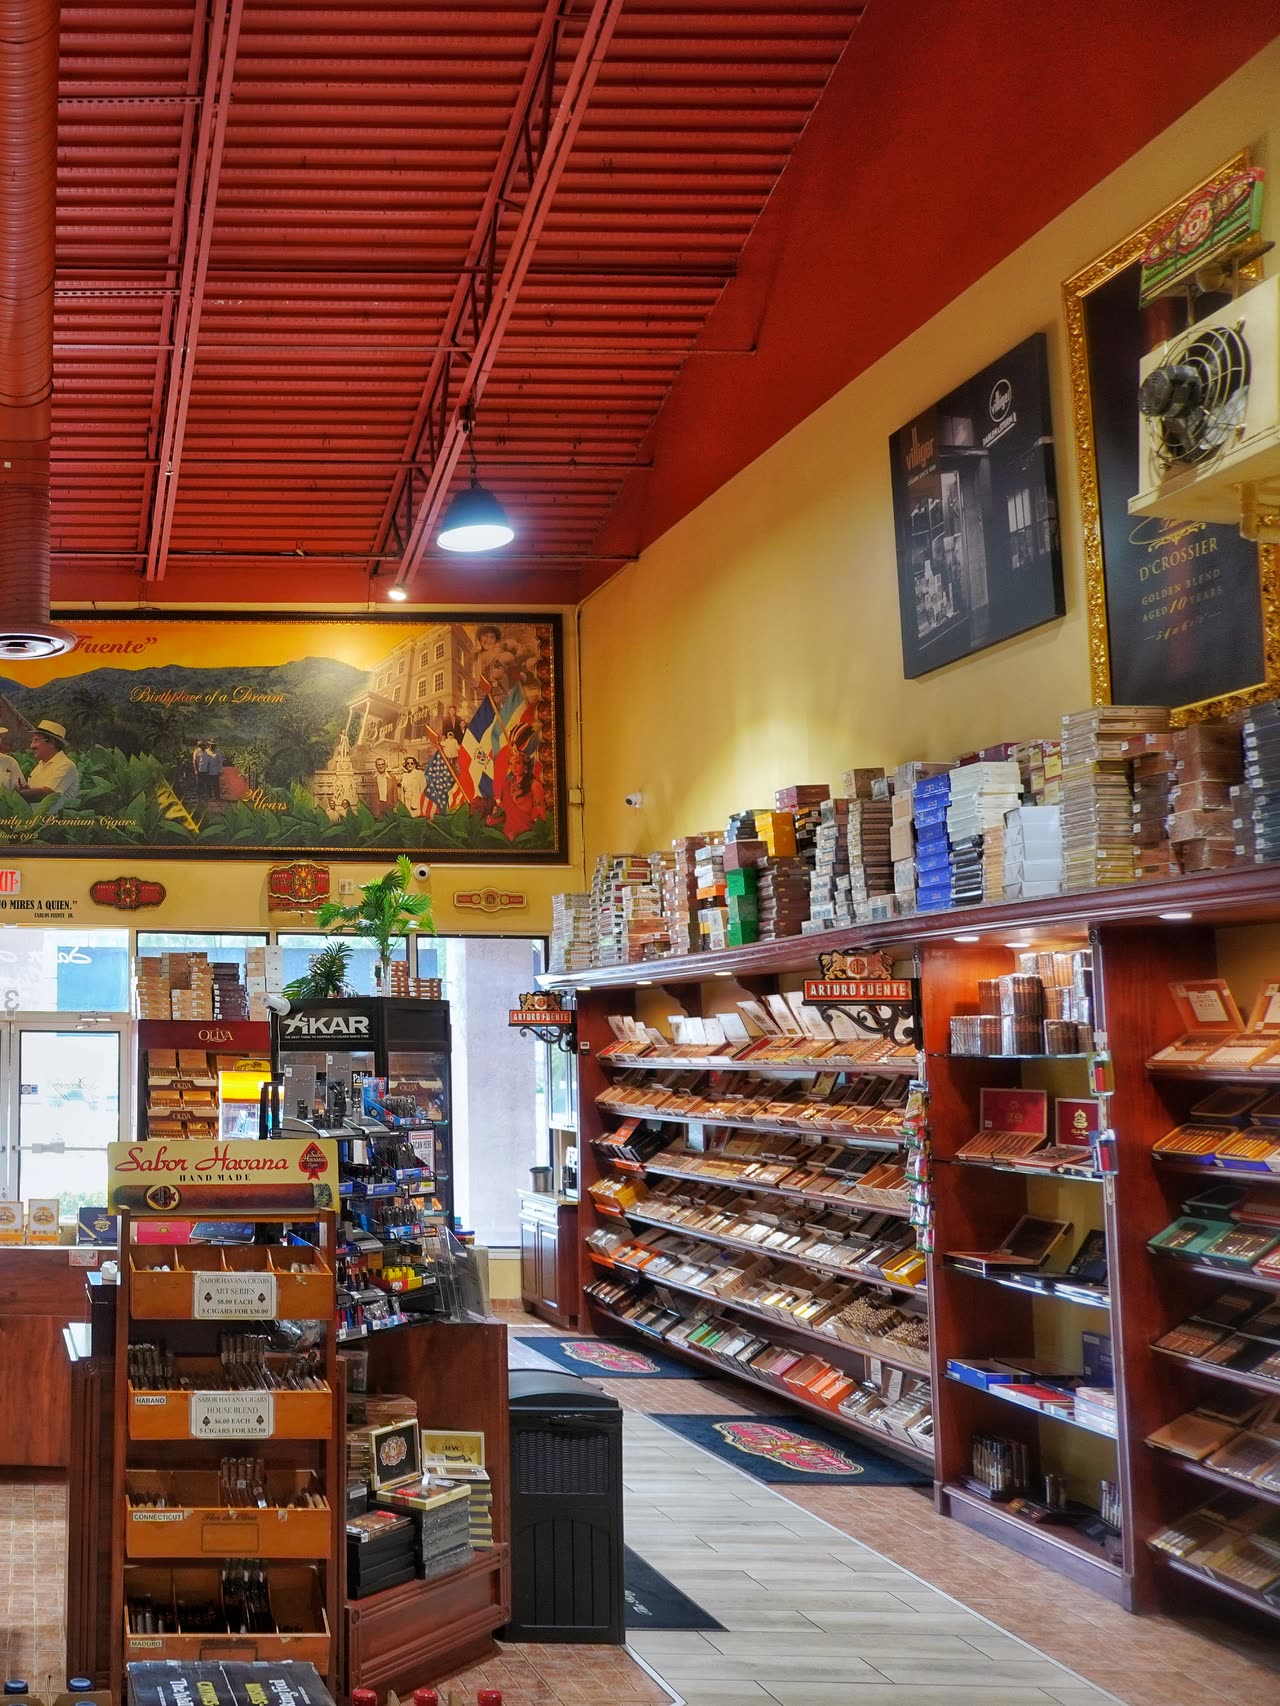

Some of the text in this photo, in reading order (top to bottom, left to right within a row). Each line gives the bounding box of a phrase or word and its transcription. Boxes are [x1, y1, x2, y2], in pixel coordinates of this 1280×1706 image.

[1142, 568, 1221, 606] GOLDEN BLEND
[1142, 606, 1168, 622] AGED
[1169, 596, 1188, 614] 10
[129, 684, 285, 708] Birthplace of a Dream
[253, 795, 288, 811] Years
[25, 814, 41, 829] of
[41, 813, 96, 827] Premium
[99, 814, 137, 830] Cigars
[10, 900, 35, 910] MIRES
[36, 900, 44, 910] A
[810, 983, 907, 997] ARTURO FUENTE
[513, 1013, 569, 1021] ARTURO FUENTE
[114, 1143, 290, 1172] Sabor Havana
[179, 1173, 251, 1182] HAND MADE
[136, 1397, 165, 1405] HABANO
[134, 1513, 181, 1521] CONNECTICUT
[131, 1640, 162, 1648] MADURO
